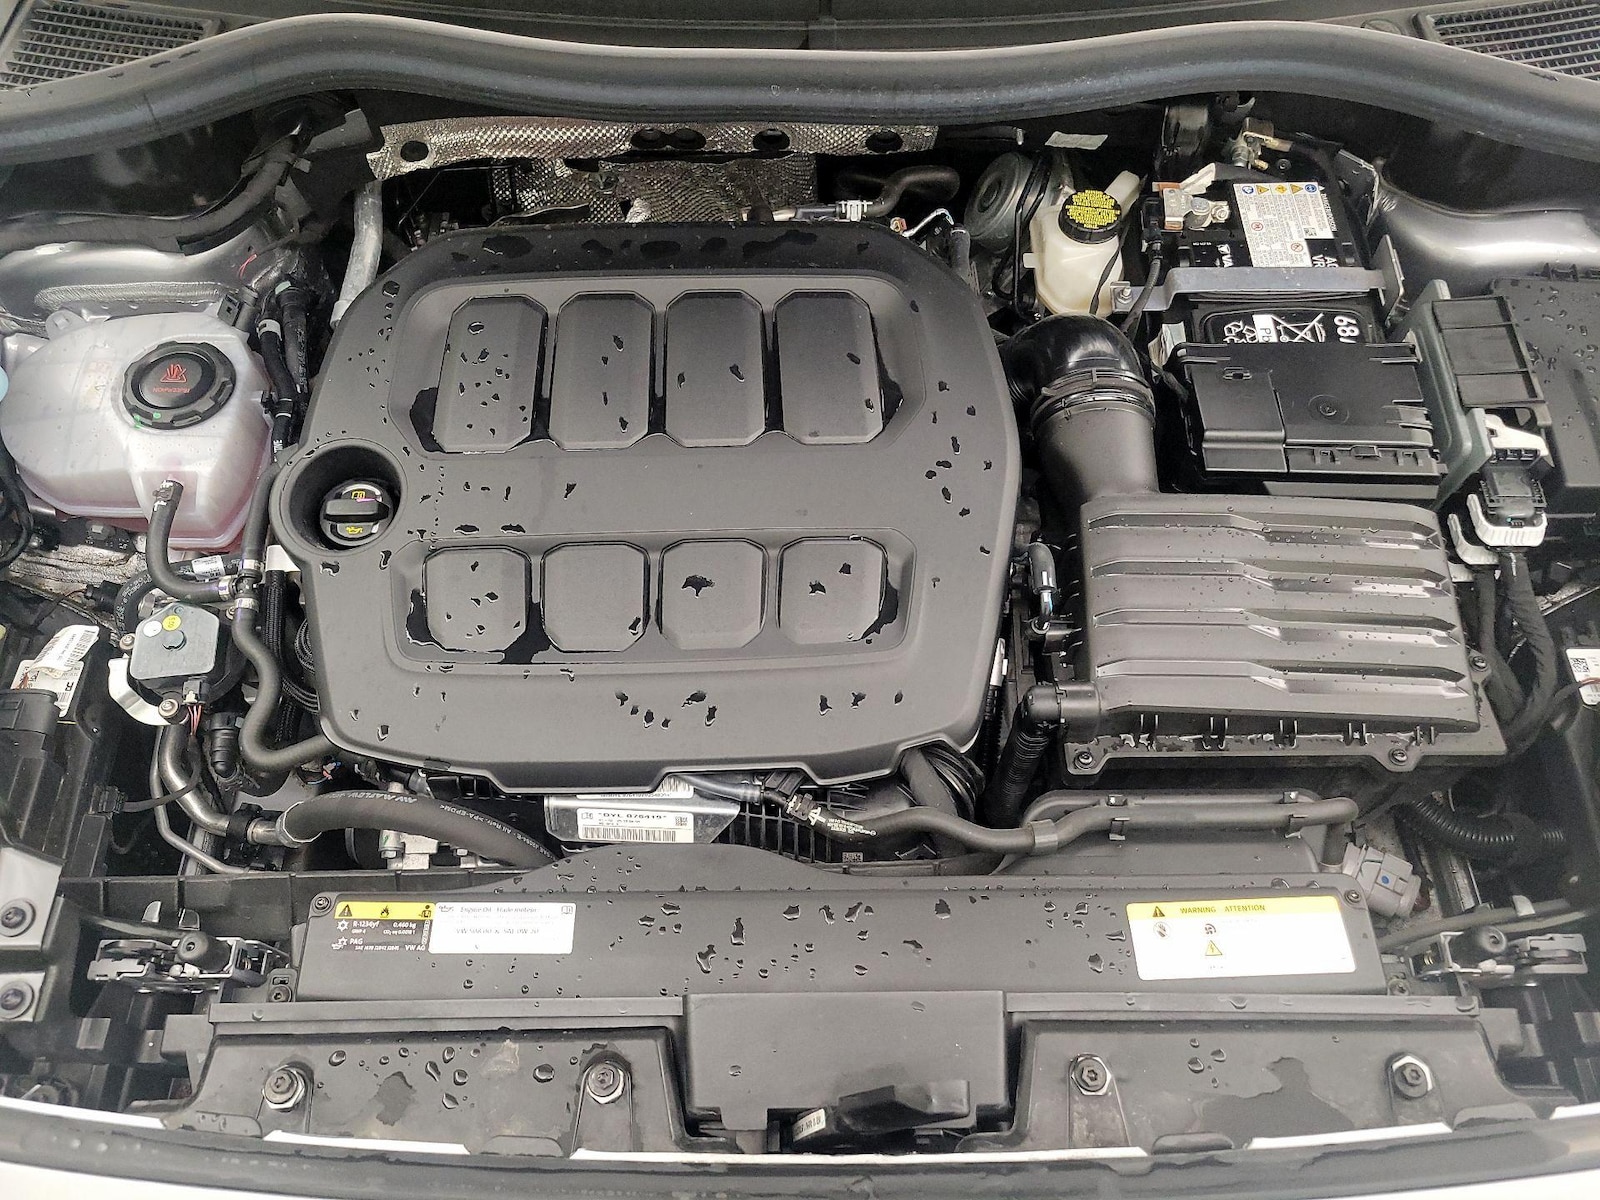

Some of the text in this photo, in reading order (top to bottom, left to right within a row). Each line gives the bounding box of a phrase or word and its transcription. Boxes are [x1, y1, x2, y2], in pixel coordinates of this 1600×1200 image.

[1259, 327, 1272, 342] Pb
[1180, 904, 1266, 915] WARNING ATTENTION
